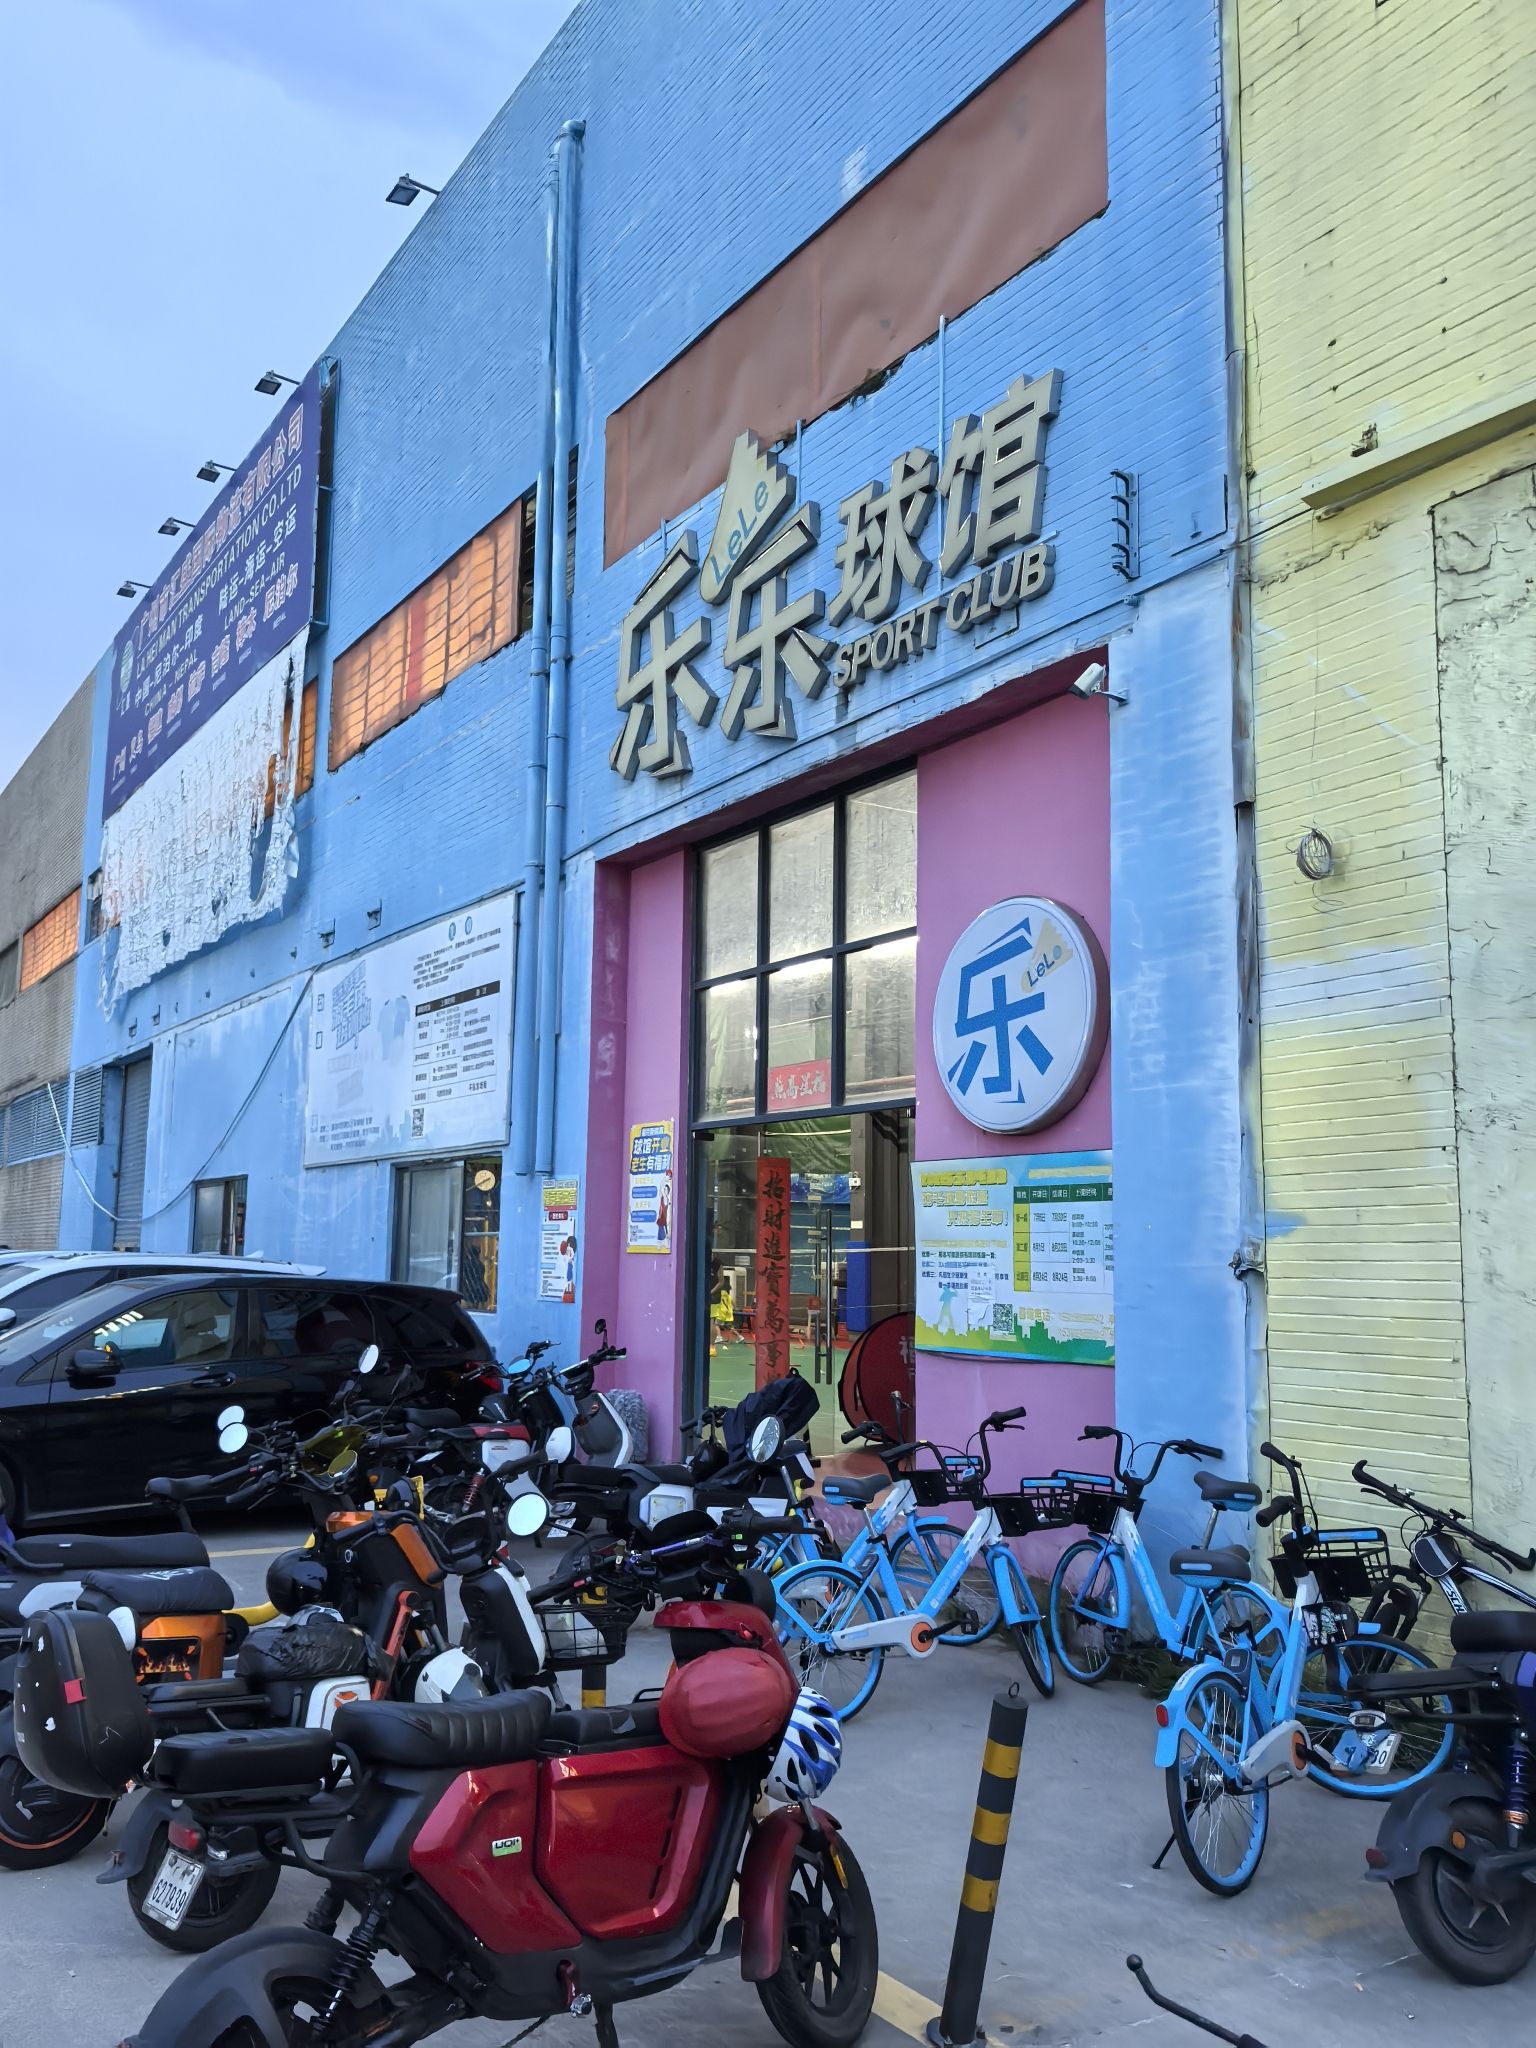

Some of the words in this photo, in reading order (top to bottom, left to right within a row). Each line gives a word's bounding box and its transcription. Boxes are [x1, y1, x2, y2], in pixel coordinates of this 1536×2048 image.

[178, 514, 259, 624] TRANSPORTATION
[609, 368, 1064, 780] 乐乐球馆
[709, 478, 770, 588] LeLe
[832, 594, 946, 688] SPORT
[945, 543, 1056, 632] CLUB
[947, 916, 1054, 1104] 乐
[152, 1879, 187, 1914] 627939
